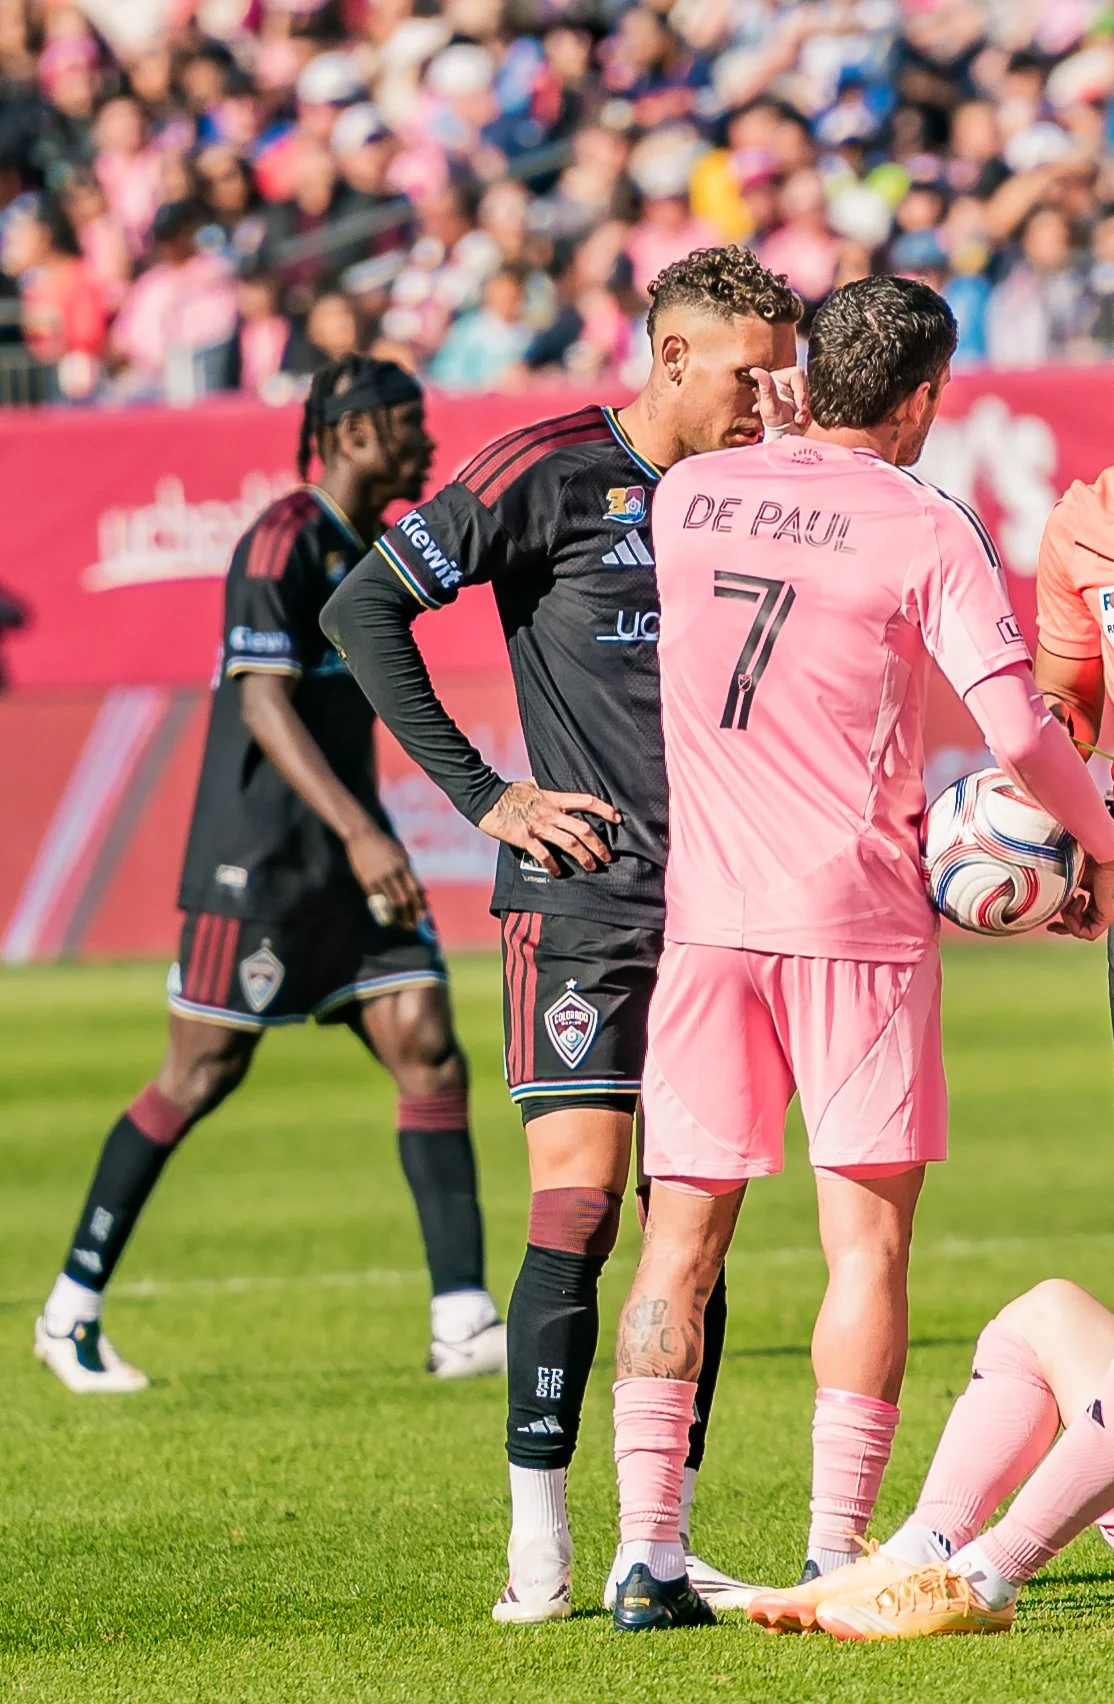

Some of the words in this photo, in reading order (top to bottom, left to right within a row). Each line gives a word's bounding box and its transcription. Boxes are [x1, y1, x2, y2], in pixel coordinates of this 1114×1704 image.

[397, 509, 463, 588] Kiewit
[683, 494, 742, 532] DE
[750, 501, 858, 555] PAUL
[714, 570, 796, 731] 7
